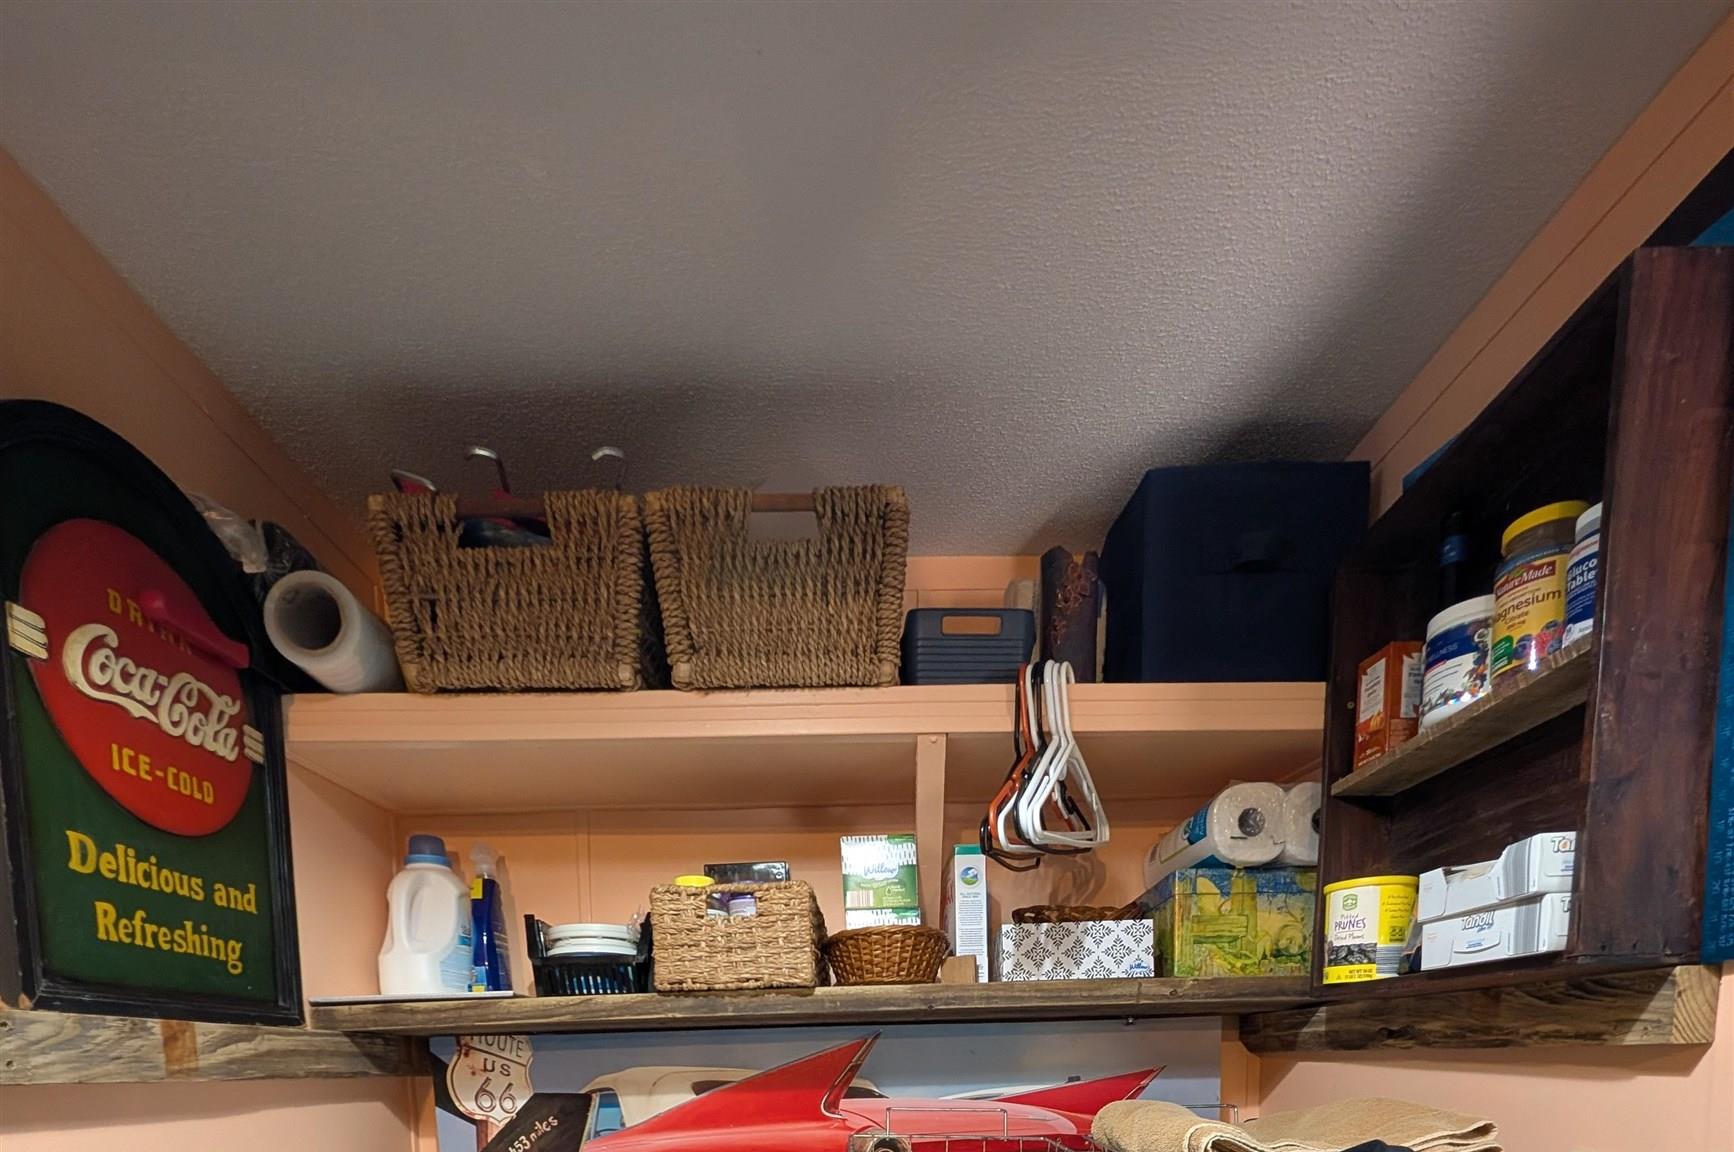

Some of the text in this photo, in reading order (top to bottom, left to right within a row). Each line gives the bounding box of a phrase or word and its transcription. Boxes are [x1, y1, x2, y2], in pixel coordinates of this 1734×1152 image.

[1496, 589, 1562, 623] agnesium
[62, 623, 240, 761] Coca-Cola
[111, 744, 214, 804] ICE-COLD
[65, 830, 258, 914] Delicious and
[94, 901, 243, 974] Refreshing
[1334, 917, 1367, 931] PRUNES
[483, 1058, 511, 1076] US
[475, 1077, 517, 1114] 66
[529, 1116, 559, 1142] miles
